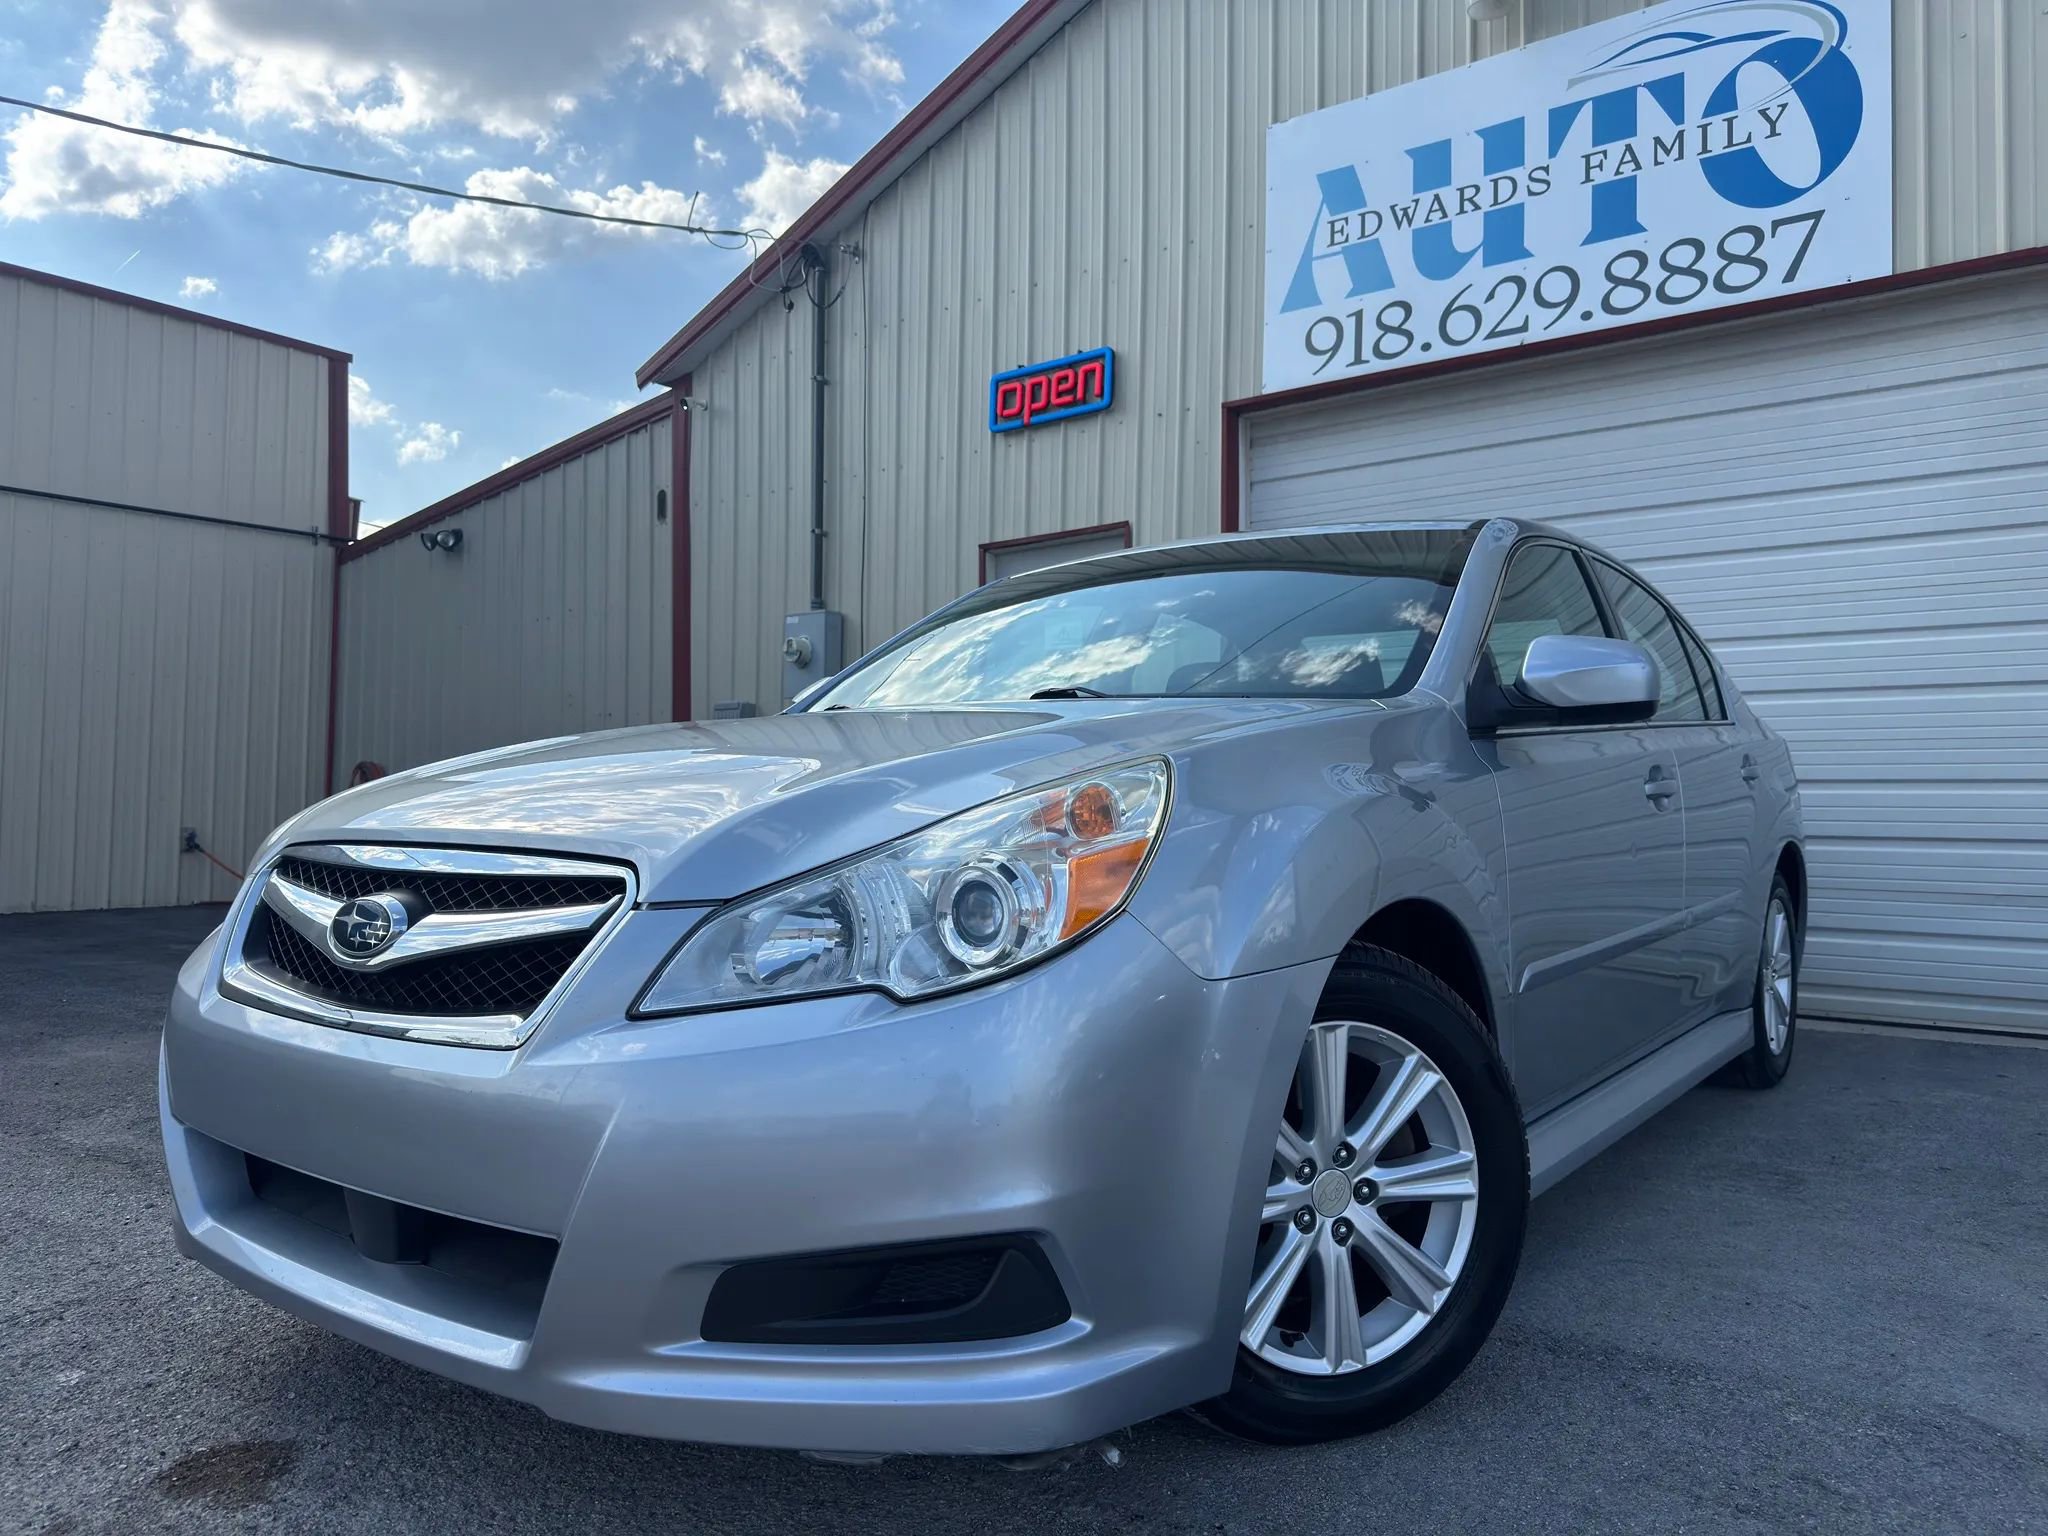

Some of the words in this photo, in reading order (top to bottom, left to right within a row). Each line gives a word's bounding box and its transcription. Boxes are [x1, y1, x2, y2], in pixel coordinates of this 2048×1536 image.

[1326, 165, 1551, 249] EDWARDS
[1580, 102, 1789, 185] FAMILY
[1304, 209, 1826, 376] 918.629.8887
[997, 361, 1104, 426] open
